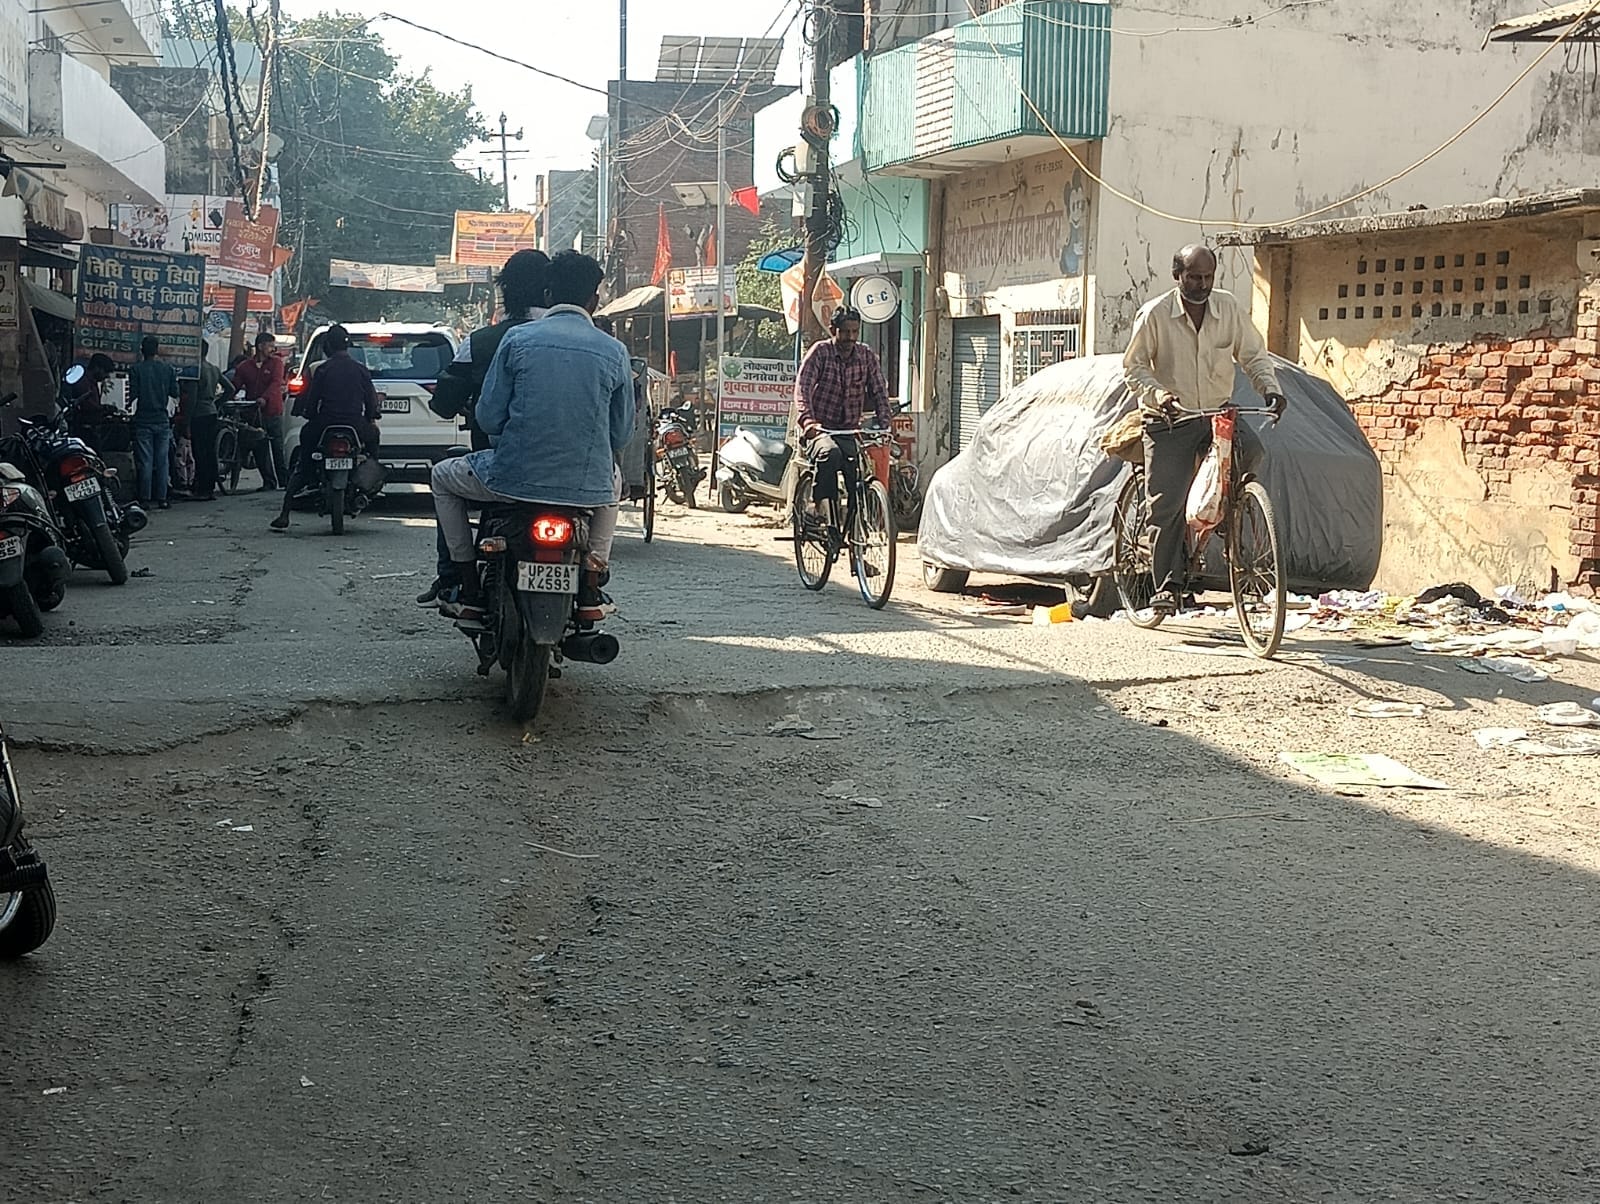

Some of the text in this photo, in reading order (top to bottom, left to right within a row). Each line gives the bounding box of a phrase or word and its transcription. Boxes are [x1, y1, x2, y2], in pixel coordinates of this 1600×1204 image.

[181, 231, 222, 243] ADMISSIO
[86, 256, 125, 279] निधि
[166, 264, 200, 285] डिपो
[84, 281, 119, 300] पुरानी
[137, 285, 157, 305] नई
[81, 338, 132, 351] GIFTS
[743, 360, 783, 372] लोकवाणी
[743, 371, 777, 382] जनसेवा
[381, 401, 408, 409] R0007
[528, 564, 570, 578] UP26A
[528, 577, 570, 591] K4593
